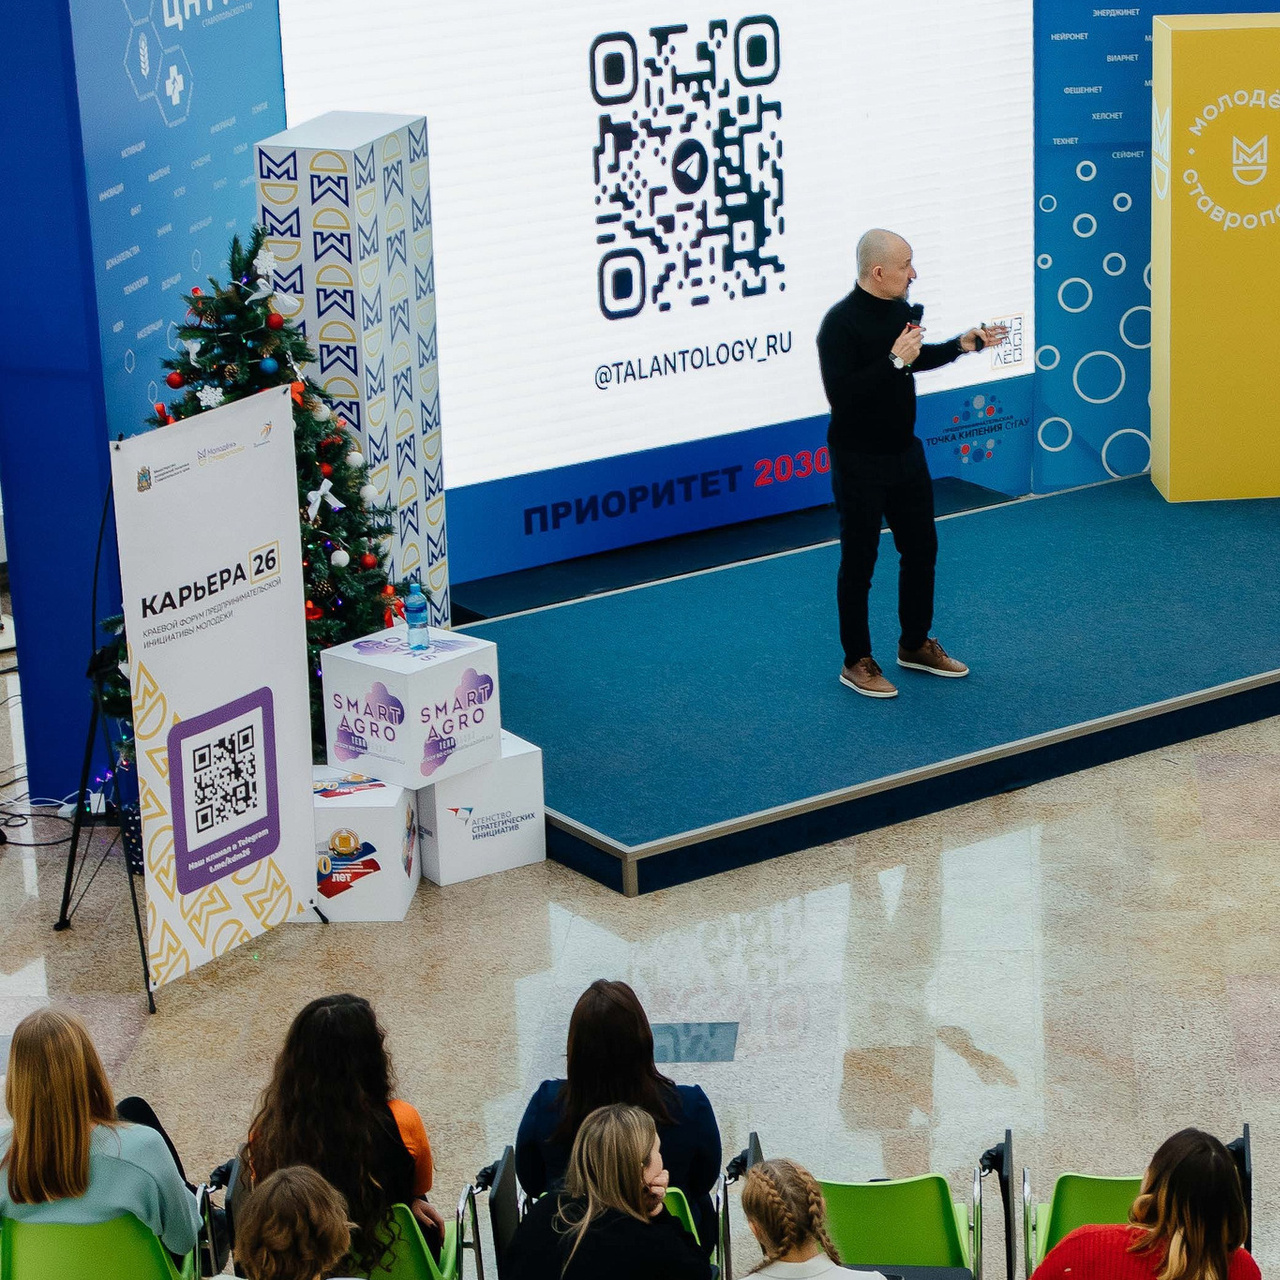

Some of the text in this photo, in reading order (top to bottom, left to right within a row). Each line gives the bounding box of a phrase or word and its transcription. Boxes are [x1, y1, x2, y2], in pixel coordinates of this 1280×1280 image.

[1092, 8, 1140, 18] ЭНЕРДЖИНЕТ
[1050, 32, 1089, 41] НЕЙРОНЕТ
[1106, 54, 1139, 63] ВИАРНЕТ
[1063, 86, 1103, 95] ФЕШЕННЕТ
[1091, 112, 1123, 120] ХЕЛСНЕТ
[1052, 137, 1079, 145] ТЕХНЕТ
[1111, 150, 1145, 159] СЕЙФНЕТ
[594, 330, 792, 390] @TALANTOLOGY_RU
[926, 433, 957, 446] ТОЧКА
[958, 424, 1003, 440] КИПЕНИЯ
[523, 465, 743, 535] ПРИОРИТЕТ
[142, 548, 277, 618] КАРЬЕРА 26
[142, 576, 282, 638] КРАЕВОЙ ФОРУМ ПРЕДПРИНИМАТЕЛЬСКОЙ
[143, 627, 195, 649] ИНИЦИАТИВЫ
[333, 693, 401, 726] SMART
[420, 684, 490, 724] SMART
[339, 714, 396, 742] AGRO
[427, 707, 485, 742] AGRO
[471, 810, 512, 826] АГЕНСТВО
[471, 812, 536, 834] СТРАТЕГИЧЕСКИХ
[237, 828, 269, 848] Telegram
[472, 824, 520, 841] ИНИЦИАТИВ
[331, 872, 352, 883] лет
